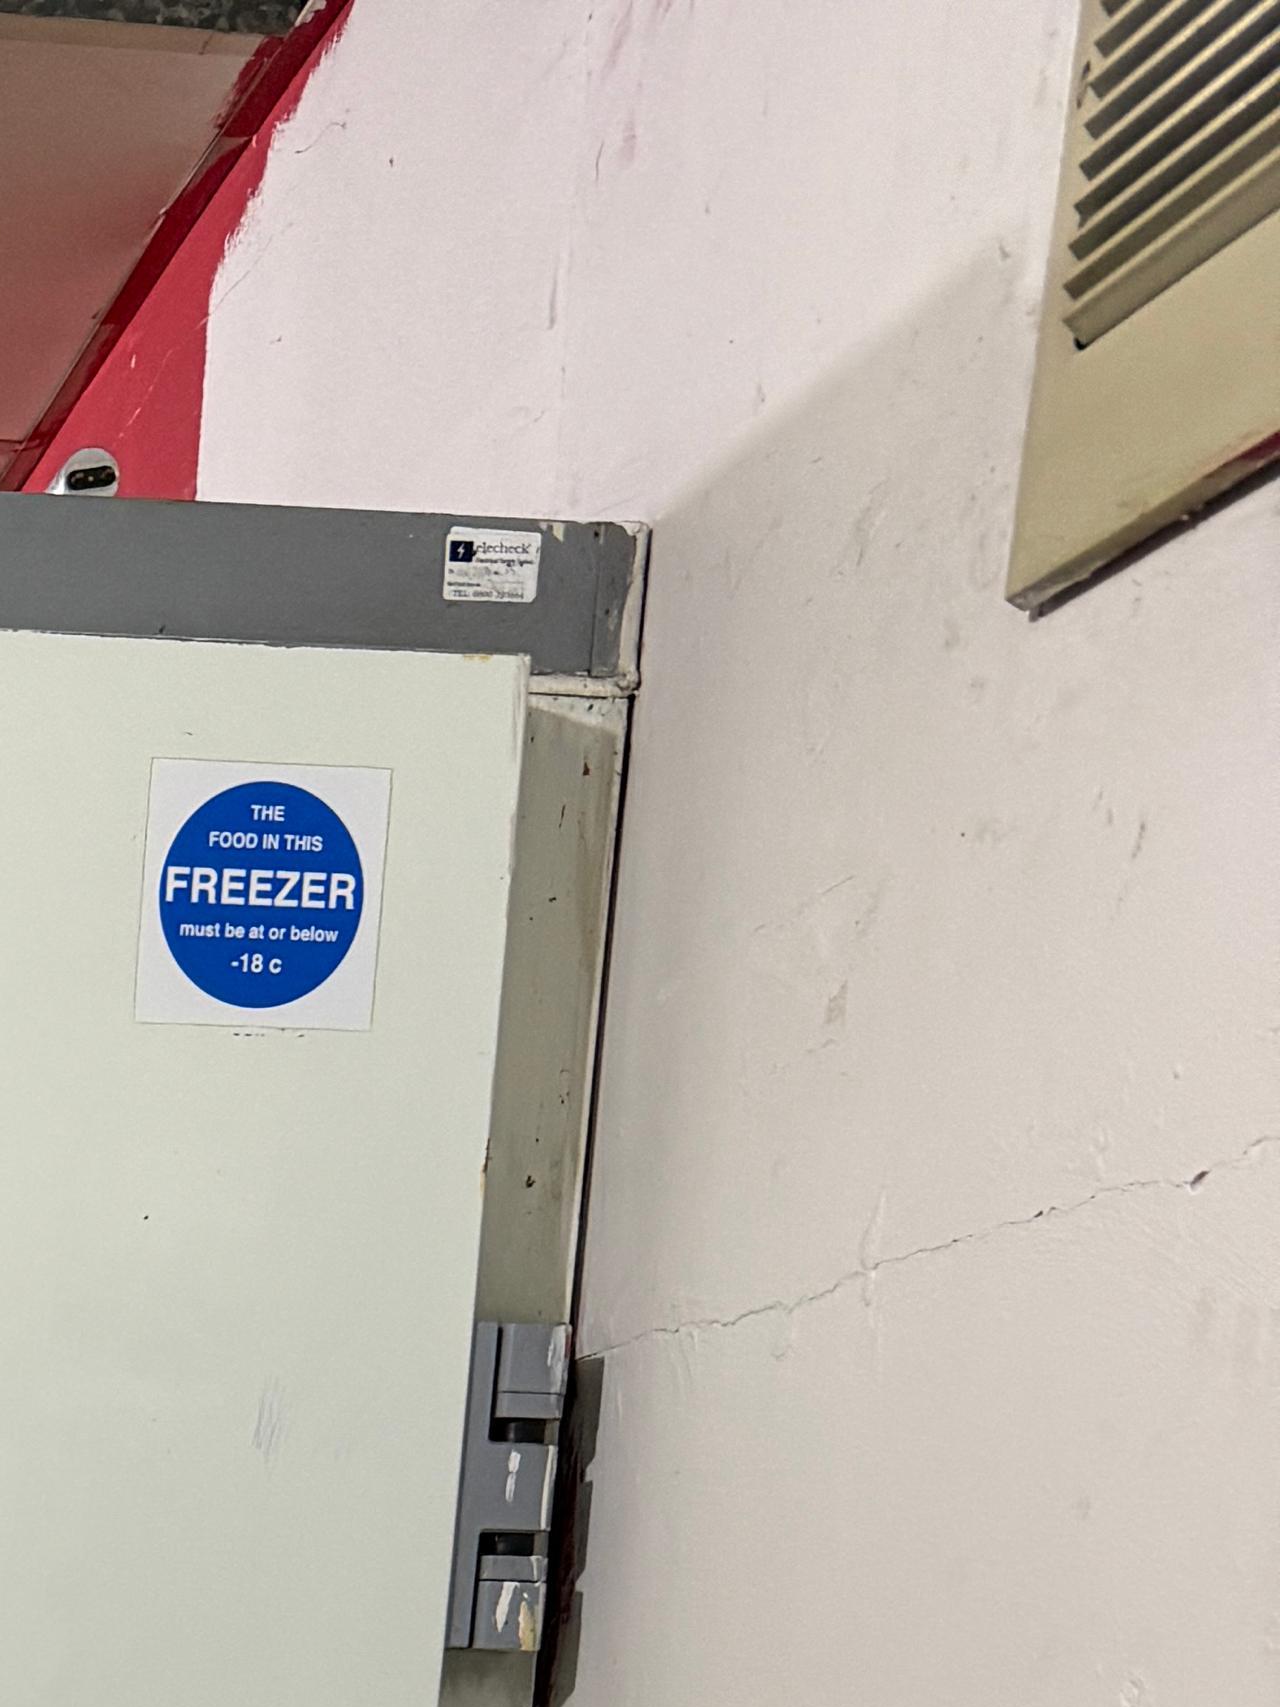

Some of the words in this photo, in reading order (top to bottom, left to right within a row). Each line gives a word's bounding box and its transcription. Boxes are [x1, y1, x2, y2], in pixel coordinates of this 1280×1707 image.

[251, 805, 285, 822] THE
[209, 831, 258, 848] FOOD
[263, 834, 280, 850] IN
[284, 834, 323, 851] THIS
[165, 866, 356, 909] FREEZER
[180, 922, 220, 938] must
[225, 923, 245, 939] be
[248, 924, 264, 939] at
[268, 927, 286, 940] or
[290, 926, 339, 942] below
[230, 953, 263, 973] -18
[269, 958, 282, 974] c
